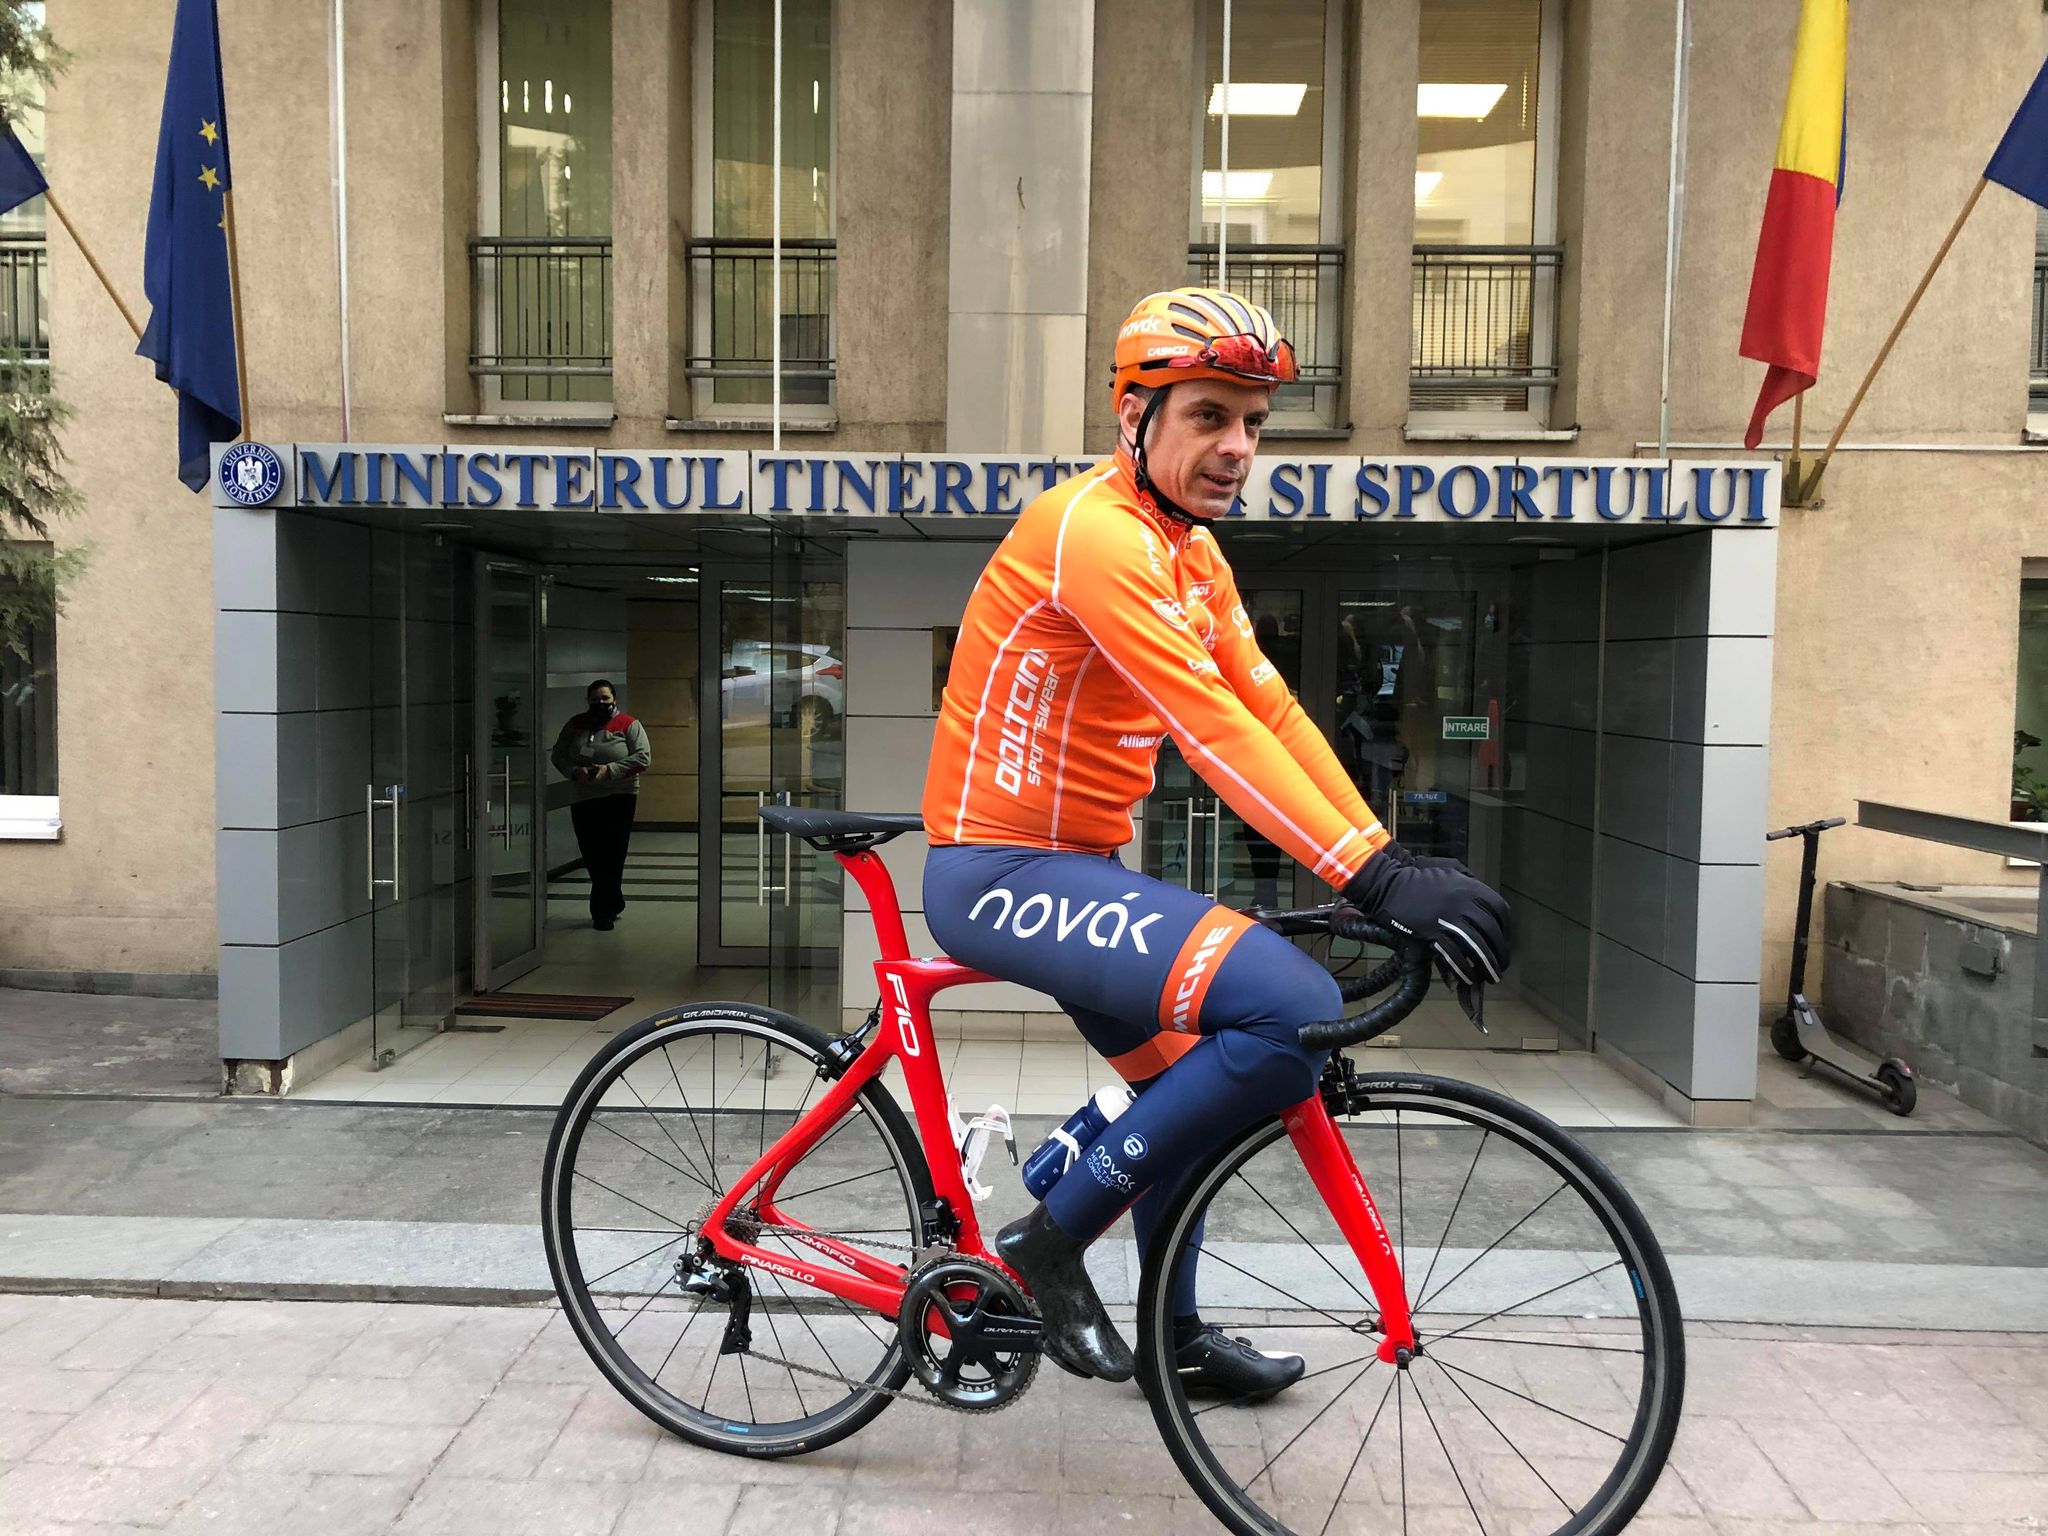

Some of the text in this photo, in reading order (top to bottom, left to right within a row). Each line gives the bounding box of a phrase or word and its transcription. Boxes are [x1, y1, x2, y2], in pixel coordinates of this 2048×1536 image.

[224, 445, 275, 468] GUVERNUL
[300, 450, 1771, 522] MINISTERUL TINERET SI SPORTULUI
[1117, 734, 1155, 748] Allianz
[1444, 722, 1487, 733] INTRARE
[968, 888, 1164, 954] novák
[1173, 925, 1233, 1034] MICHE
[1086, 1158, 1111, 1189] CONCEPT
[1096, 1145, 1136, 1190] novák
[741, 1254, 815, 1283] PINARELLO
